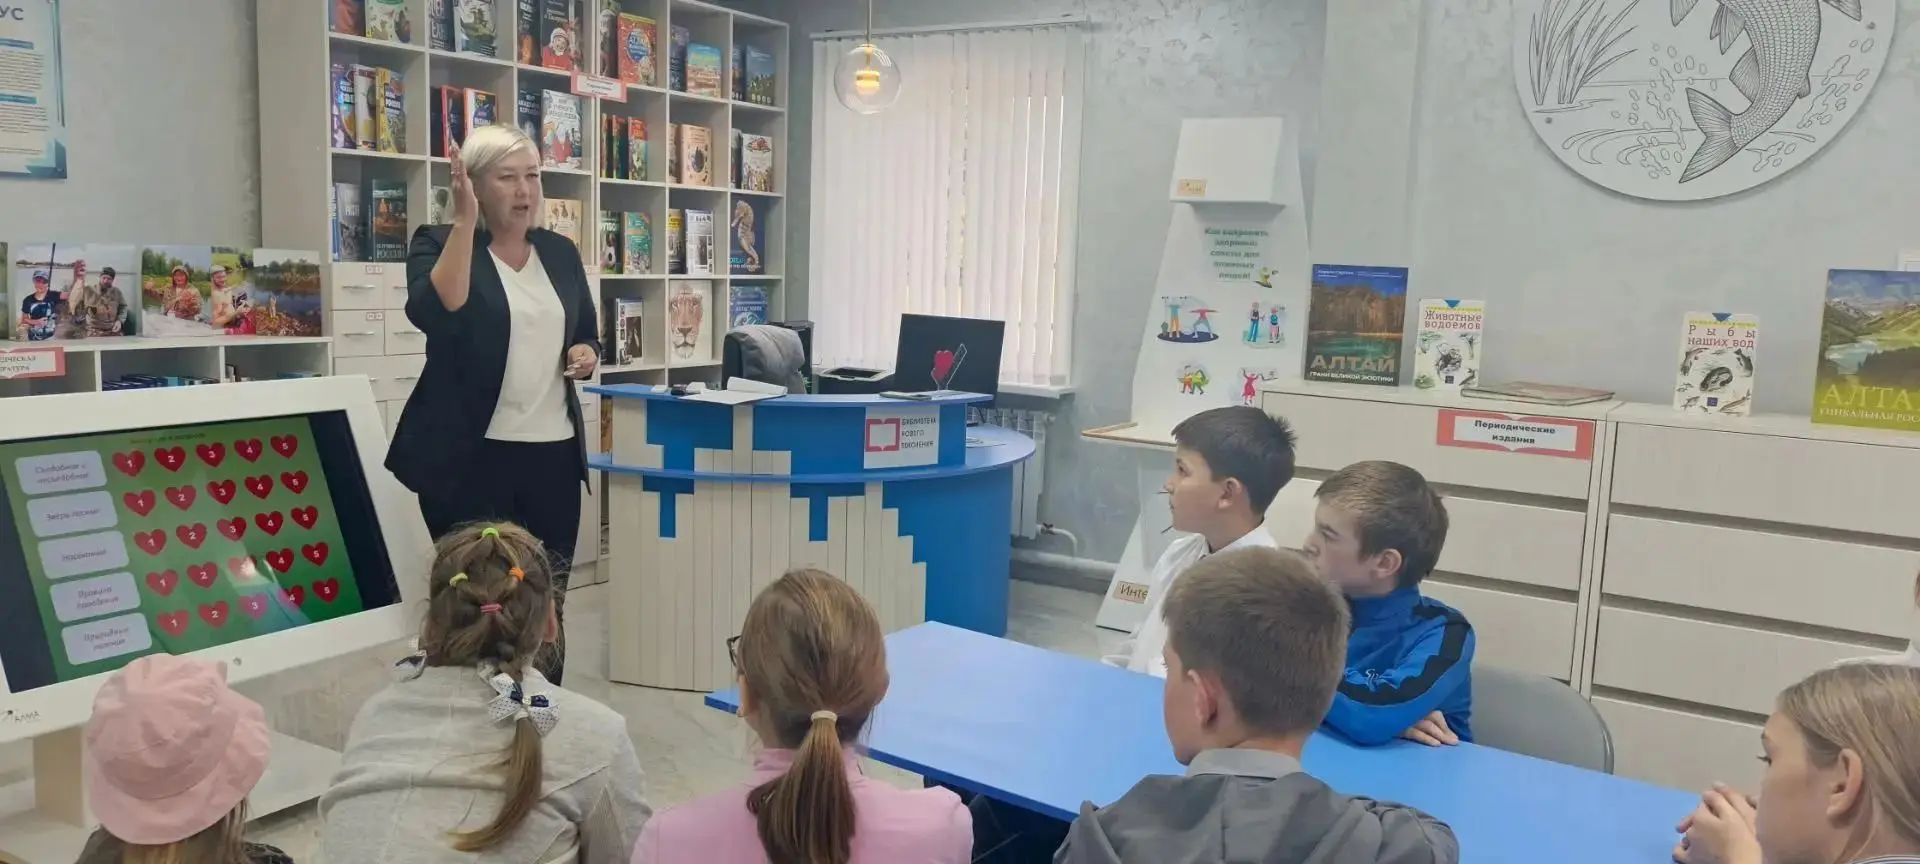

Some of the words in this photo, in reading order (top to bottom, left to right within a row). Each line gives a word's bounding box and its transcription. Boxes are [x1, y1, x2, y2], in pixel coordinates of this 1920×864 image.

[1424, 310, 1482, 322] Животные
[1424, 320, 1480, 330] водоемов
[1688, 324, 1756, 338] Рыбы
[1310, 349, 1396, 372] АЛТАЙ
[1820, 384, 1920, 411] АЛТА
[901, 417, 937, 426] БИБЛИОТЕКА
[1474, 420, 1556, 434] Периодические
[901, 429, 925, 438] НОВОГО
[1492, 434, 1536, 444] издания
[1120, 584, 1148, 600] Инте
